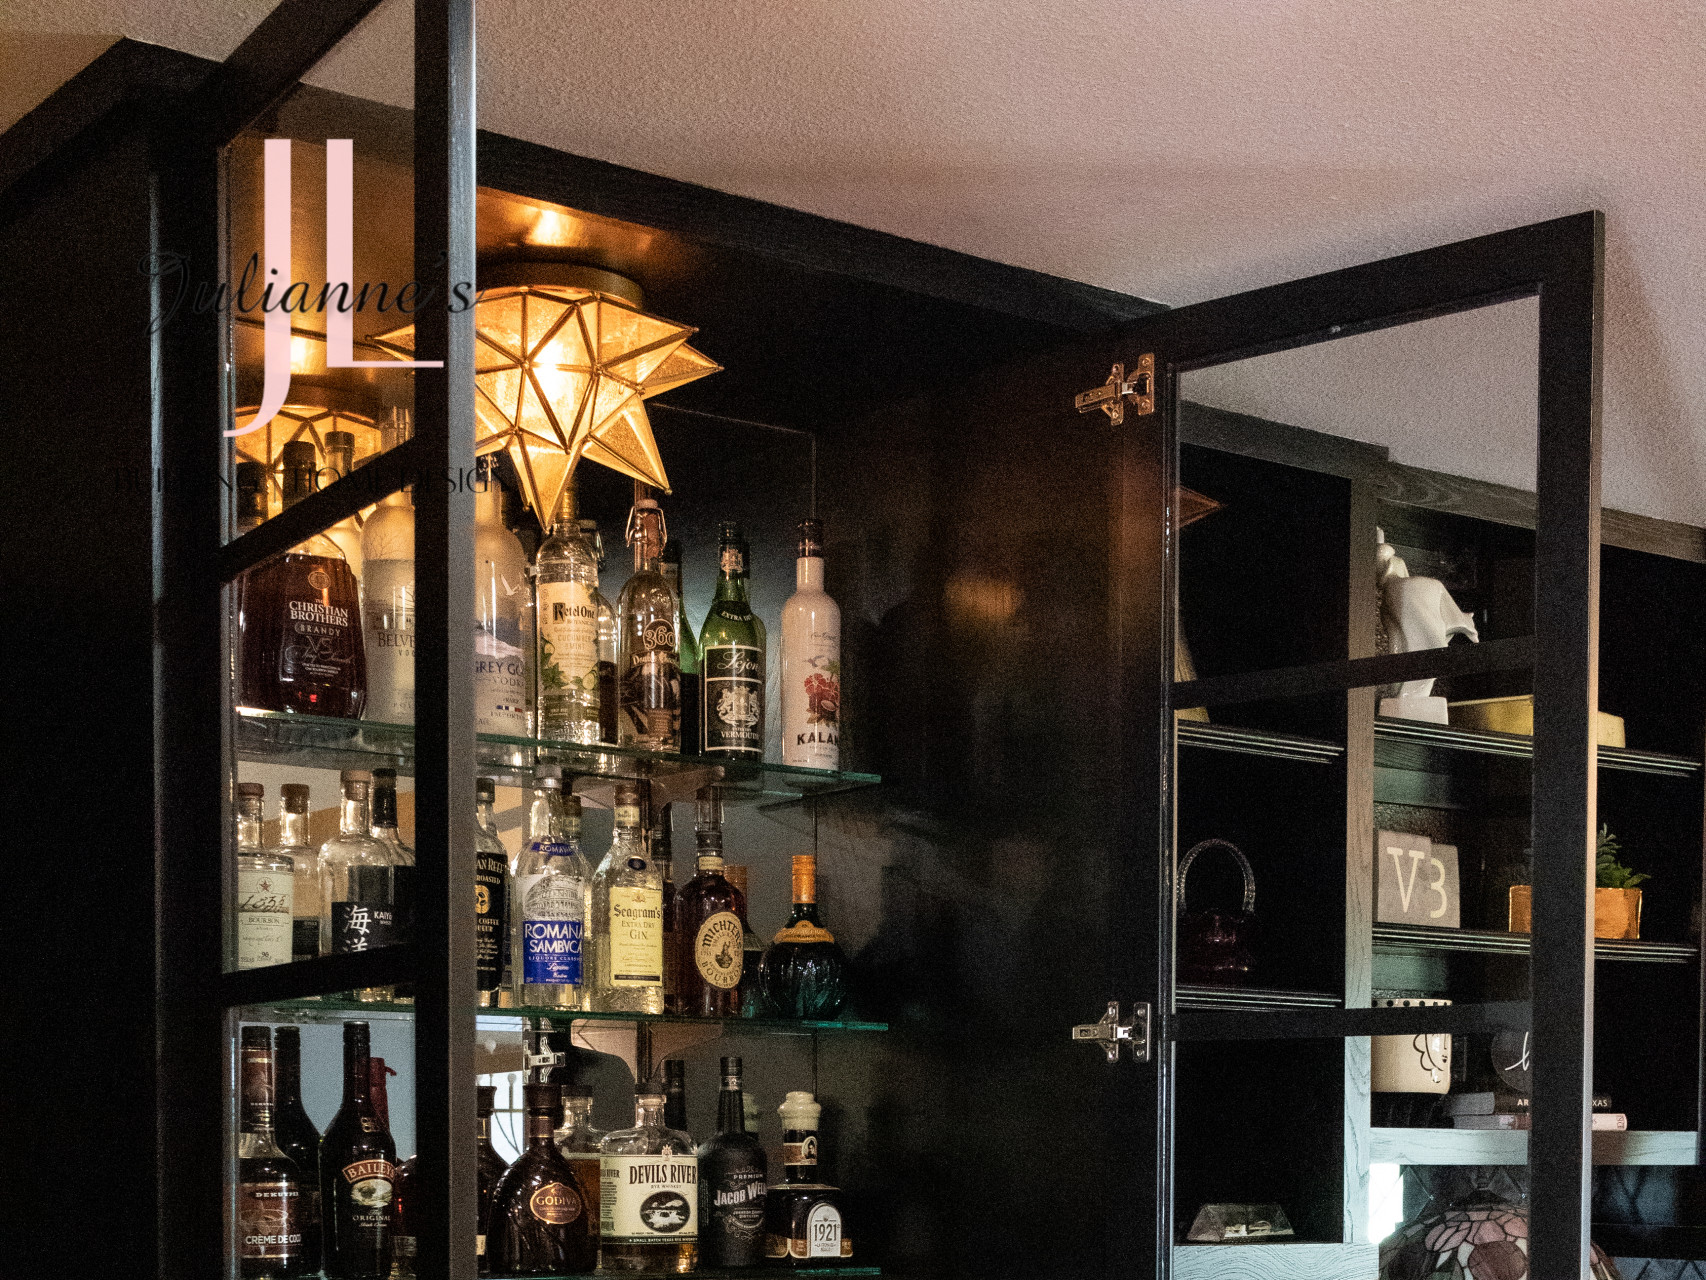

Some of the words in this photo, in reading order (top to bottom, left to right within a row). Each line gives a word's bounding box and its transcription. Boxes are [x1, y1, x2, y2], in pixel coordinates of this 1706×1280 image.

[289, 601, 348, 617] CHRISTIAN
[580, 606, 595, 619] One
[290, 610, 348, 627] BROTHERS
[300, 624, 341, 637] BRANDY
[377, 632, 415, 648] BELVE
[644, 626, 675, 650] 360
[797, 732, 839, 745] KALAN
[613, 903, 661, 920] Seagram's
[643, 921, 655, 929] DRY
[629, 928, 649, 940] GIN
[1592, 1099, 1608, 1107] XAS
[629, 1164, 667, 1185] DEVILS
[669, 1164, 697, 1184] RIVER
[535, 1196, 577, 1206] GODIVA
[713, 1188, 746, 1207] JACOB
[352, 1214, 391, 1222] ORIGINAL
[245, 1233, 277, 1245] CRÈME
[277, 1235, 289, 1244] DE
[814, 1223, 837, 1242] 1921
